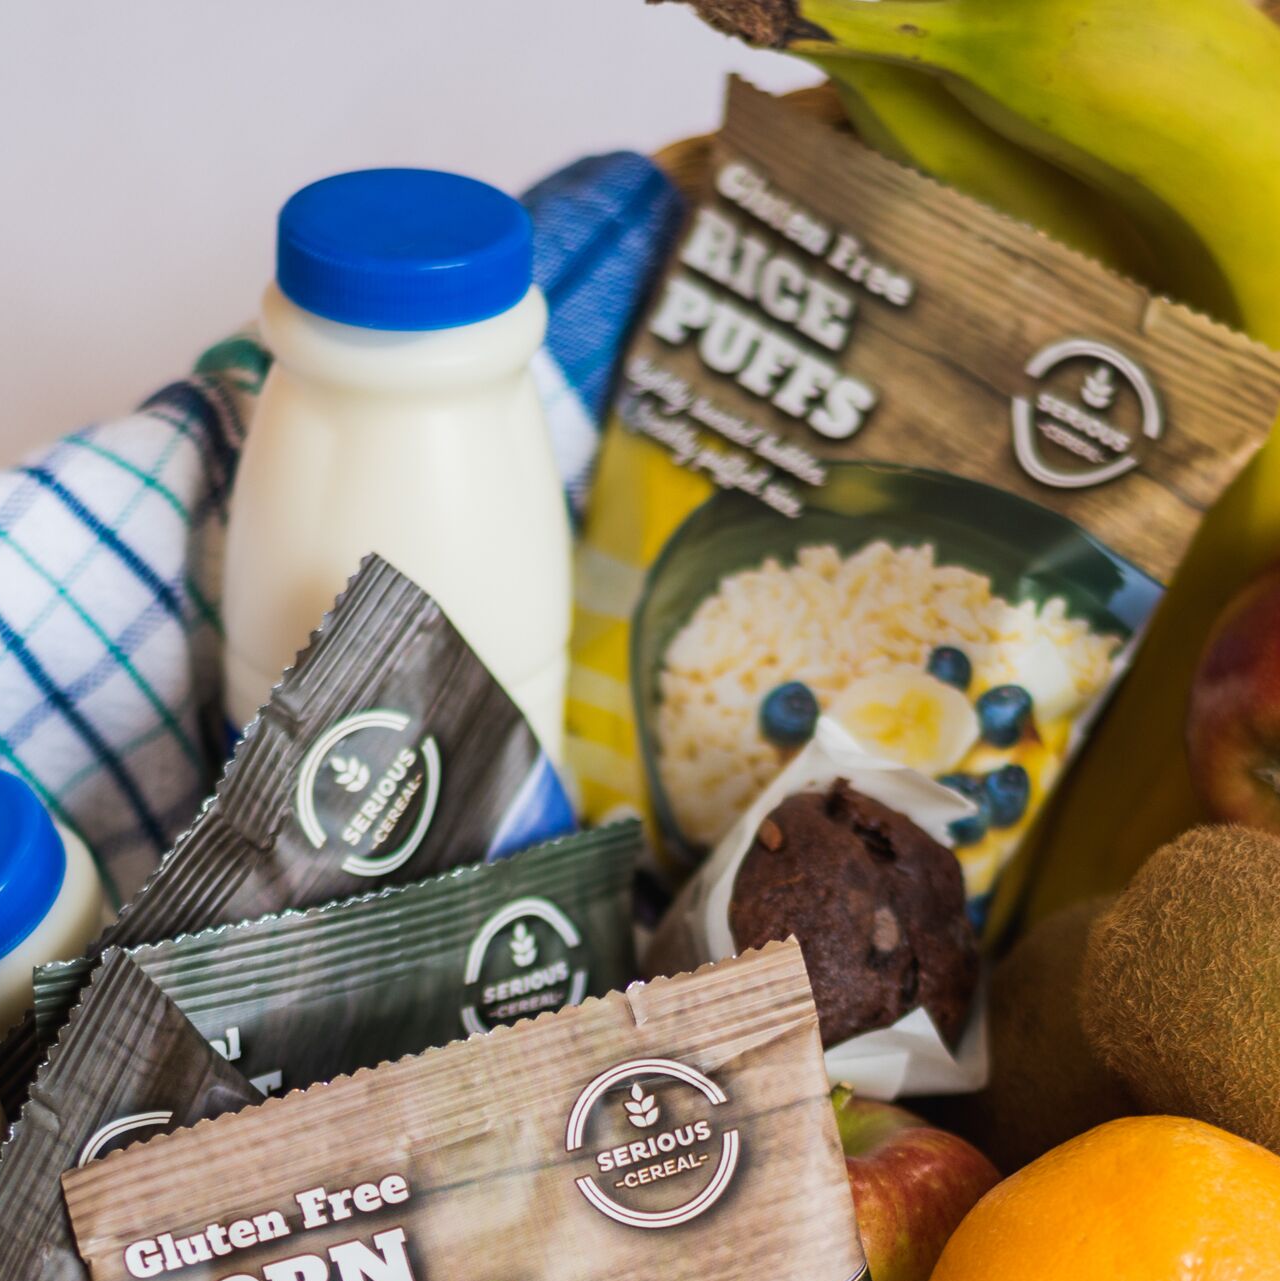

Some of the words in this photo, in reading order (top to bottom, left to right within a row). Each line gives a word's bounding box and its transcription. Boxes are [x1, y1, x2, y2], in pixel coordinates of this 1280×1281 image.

[680, 207, 856, 352] RICE
[650, 275, 876, 440] PUFFS
[342, 747, 417, 847] SERIOUS
[482, 961, 569, 1006] SERIOUS
[597, 1119, 711, 1174] SERIOUS
[123, 1205, 291, 1281] Gluten
[294, 1173, 410, 1238] Free
